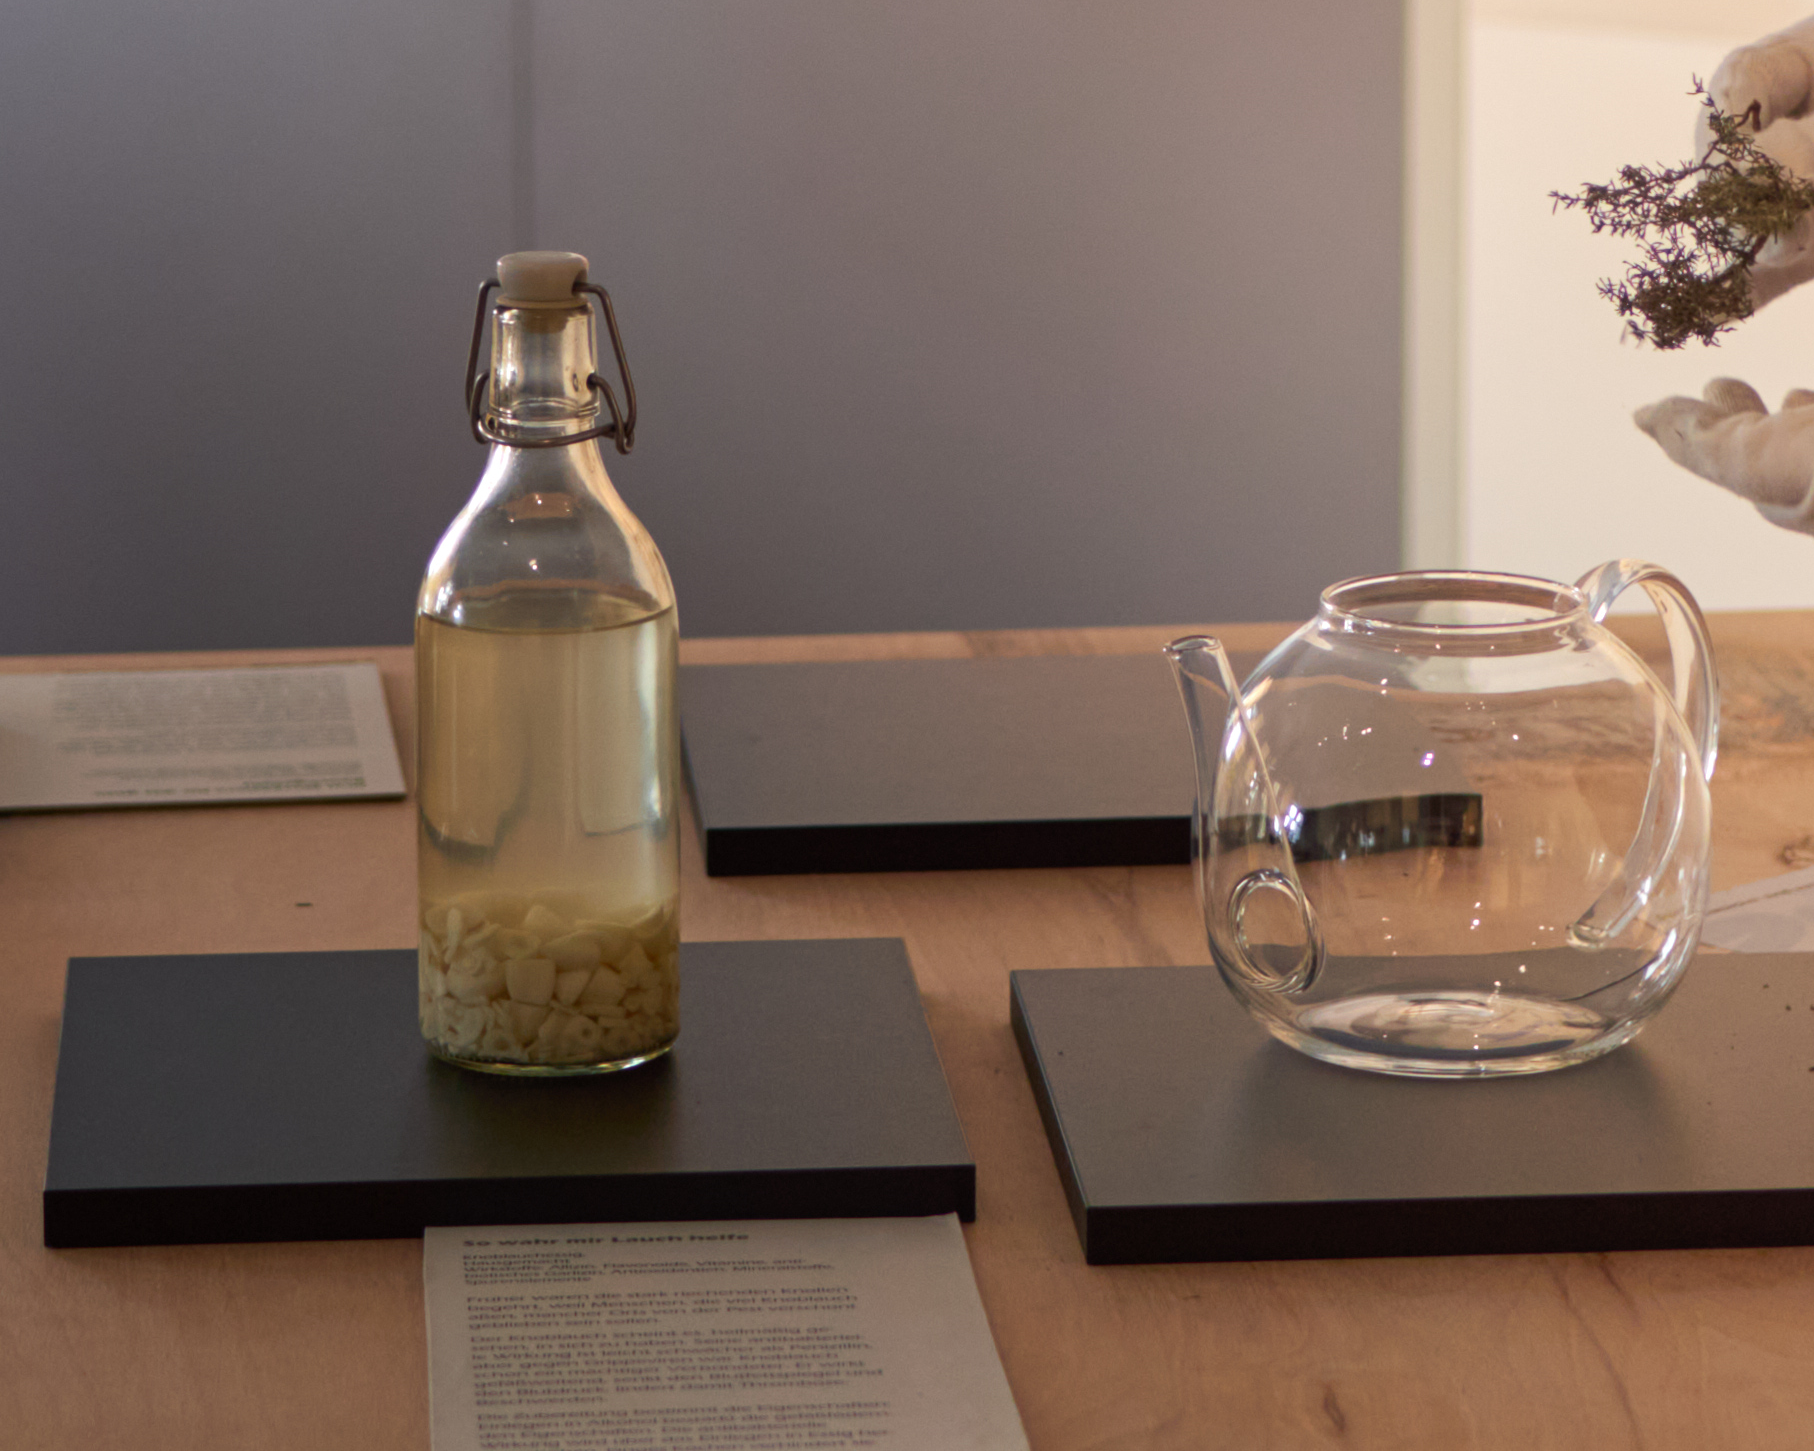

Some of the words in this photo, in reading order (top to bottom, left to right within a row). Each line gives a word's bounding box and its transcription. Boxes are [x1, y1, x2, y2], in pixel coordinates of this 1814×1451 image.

[499, 1238, 557, 1246] wahr
[611, 1235, 681, 1243] Lauch
[690, 1233, 748, 1241] helfe
